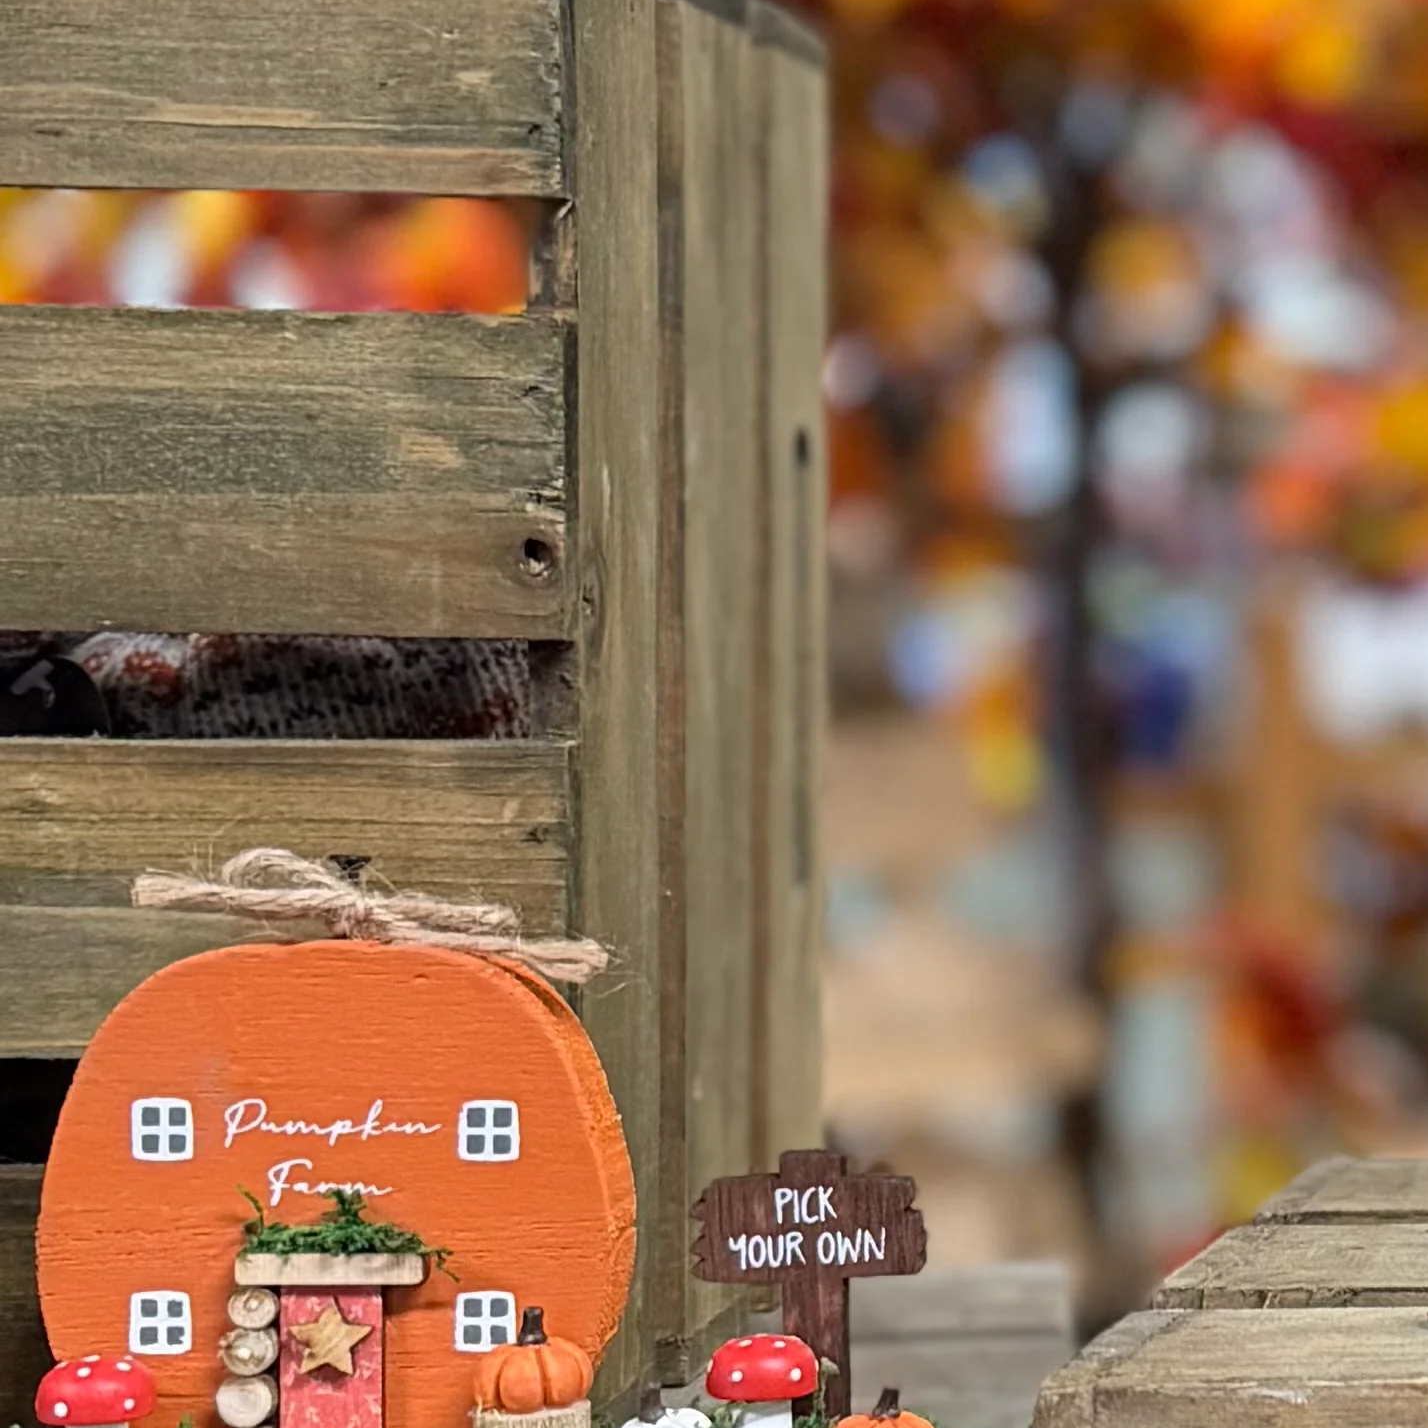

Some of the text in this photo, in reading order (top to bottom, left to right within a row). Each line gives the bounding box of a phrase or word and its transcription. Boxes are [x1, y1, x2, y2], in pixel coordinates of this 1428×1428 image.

[223, 1098, 442, 1149] Pumpkin
[267, 1158, 393, 1207] Farm
[774, 1185, 838, 1224] PICK
[728, 1226, 886, 1271] YOUR OWN
